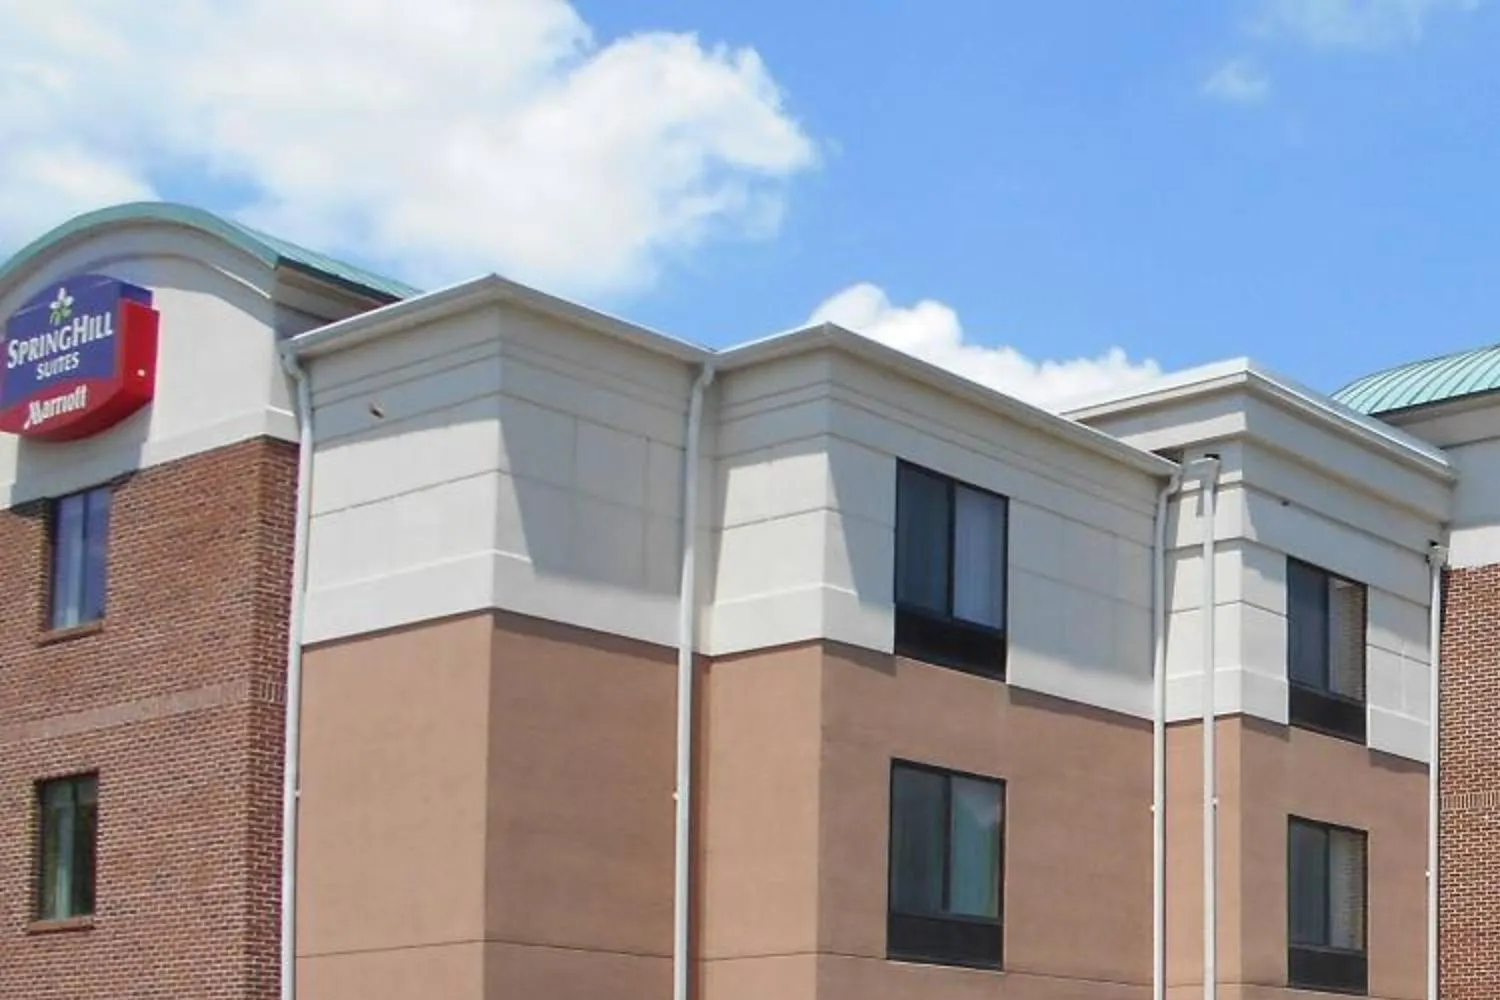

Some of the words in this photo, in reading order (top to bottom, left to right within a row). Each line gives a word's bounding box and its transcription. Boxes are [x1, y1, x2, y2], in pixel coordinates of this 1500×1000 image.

[8, 312, 113, 368] SPRINGHILL
[36, 351, 80, 380] SUITES
[24, 384, 87, 430] Marriott
